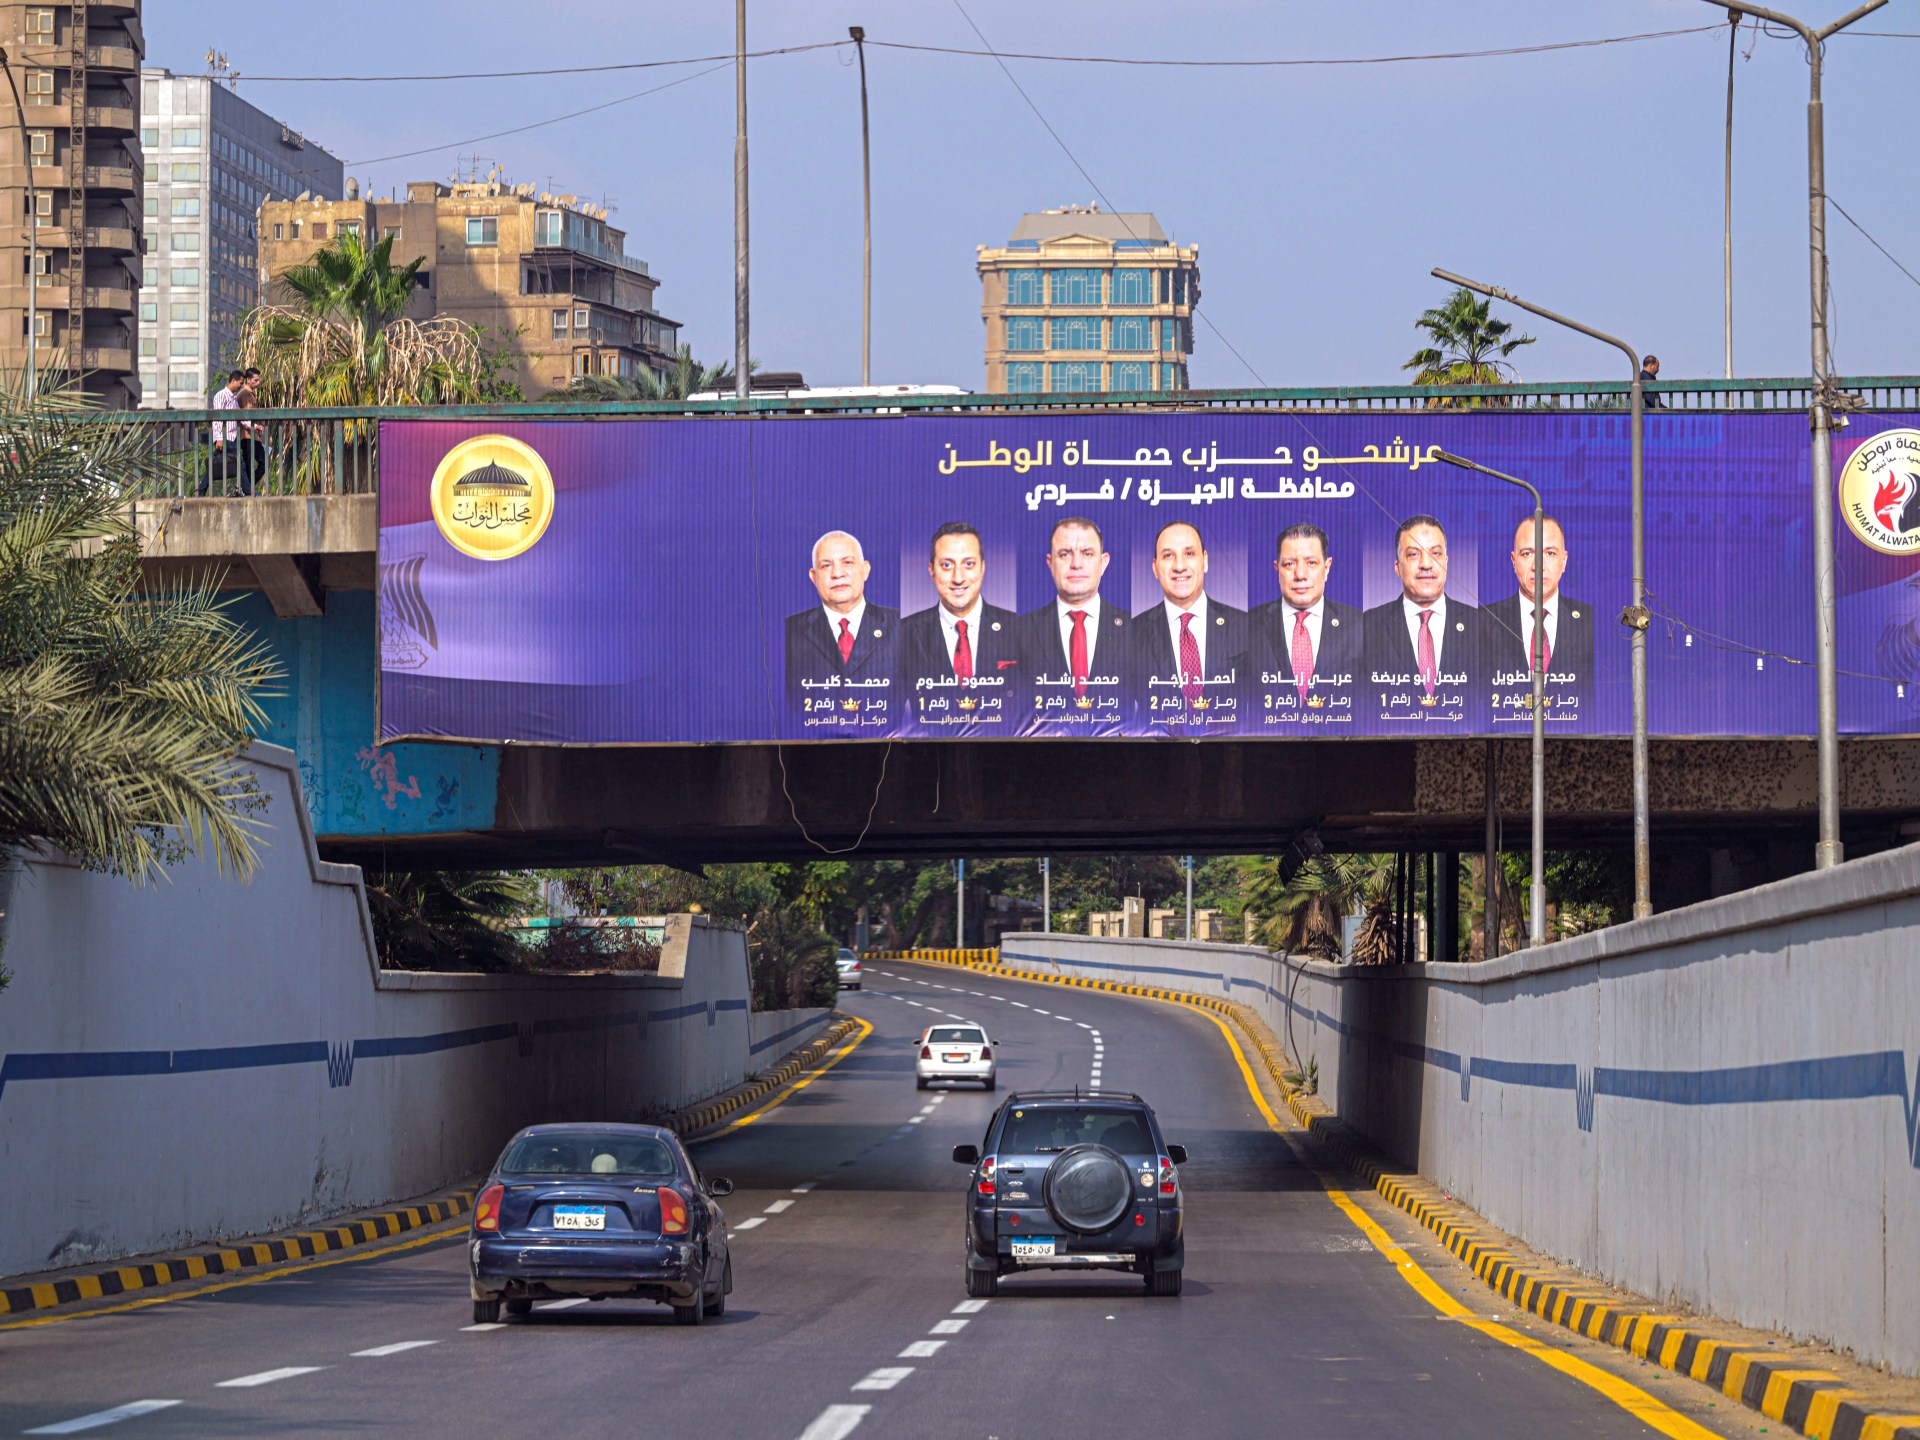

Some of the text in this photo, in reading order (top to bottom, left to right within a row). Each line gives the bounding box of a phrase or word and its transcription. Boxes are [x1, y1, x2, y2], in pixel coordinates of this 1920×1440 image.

[938, 436, 1441, 474] مرشحو حزب حماة الوطن
[1857, 437, 1920, 471] ماة الوطن
[1025, 476, 1354, 510] محافظة الجيزة / فردي
[486, 502, 531, 529] مجلس
[1852, 502, 1920, 545] HUMAT ALWATA
[801, 675, 889, 690] محمد كليب
[916, 675, 1004, 690] محمود لملوم
[1035, 672, 1119, 688] محمد رشاد
[1193, 668, 1235, 685] أحمد
[1261, 671, 1352, 689] عربي زيادة
[1371, 671, 1411, 685] عريضة
[1434, 671, 1467, 685] فيصل
[804, 697, 887, 712] رمز رقم 2
[919, 696, 1002, 711] رمز رقم 1
[1035, 695, 1119, 711] رمز رقم 2
[1150, 695, 1237, 711] رمز رقم 2
[1264, 694, 1351, 709] رمز رقم 3
[1381, 693, 1463, 707] رمز رقم 1
[1492, 694, 1499, 707] 2
[1556, 694, 1579, 707] رمز
[804, 714, 837, 726] النمرس
[861, 716, 887, 726] مركز
[920, 714, 1002, 724] قسم العمرانية
[1034, 713, 1120, 725] مركز البدرشين
[1150, 712, 1236, 725] قسم أول أكتوبر
[1264, 713, 1352, 724] قسم بولاق الدكرور
[1380, 711, 1463, 721] مركز الصف
